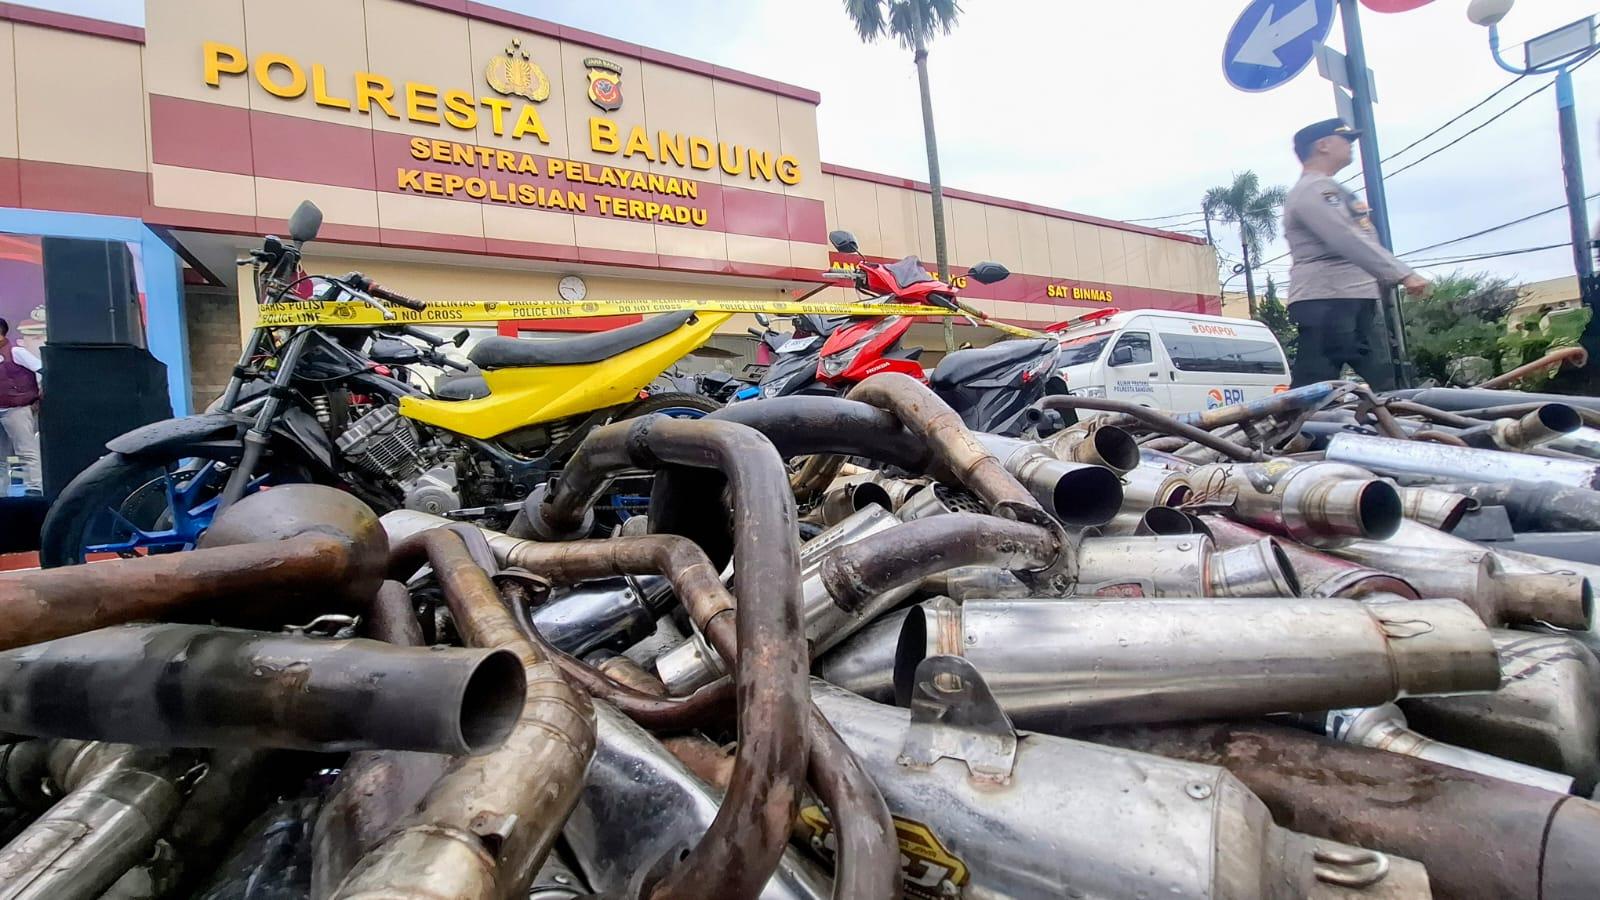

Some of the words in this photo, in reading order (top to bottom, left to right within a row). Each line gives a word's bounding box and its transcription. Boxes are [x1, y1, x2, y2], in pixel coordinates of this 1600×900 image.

[203, 40, 550, 144] POLRESTA
[589, 116, 803, 186] BANDUNG
[410, 137, 539, 176] SENTRA
[547, 158, 698, 199] PELAYANAN
[397, 167, 587, 212] KEPOLISIAN
[594, 194, 708, 226] TERPADU
[1047, 284, 1069, 299] SAT
[1072, 287, 1113, 303] BINMAS
[512, 306, 548, 317] POLICE
[551, 305, 573, 316] LINE
[619, 304, 632, 313] DO
[634, 303, 651, 313] NOT
[654, 303, 683, 311] CROSS
[719, 302, 746, 311] POLICE
[262, 312, 294, 324] POLICE
[297, 312, 321, 322] LINE
[402, 308, 423, 321] NOT
[427, 309, 463, 321] CROSS
[866, 362, 891, 375] HONDA
[1224, 389, 1245, 406] BRI
